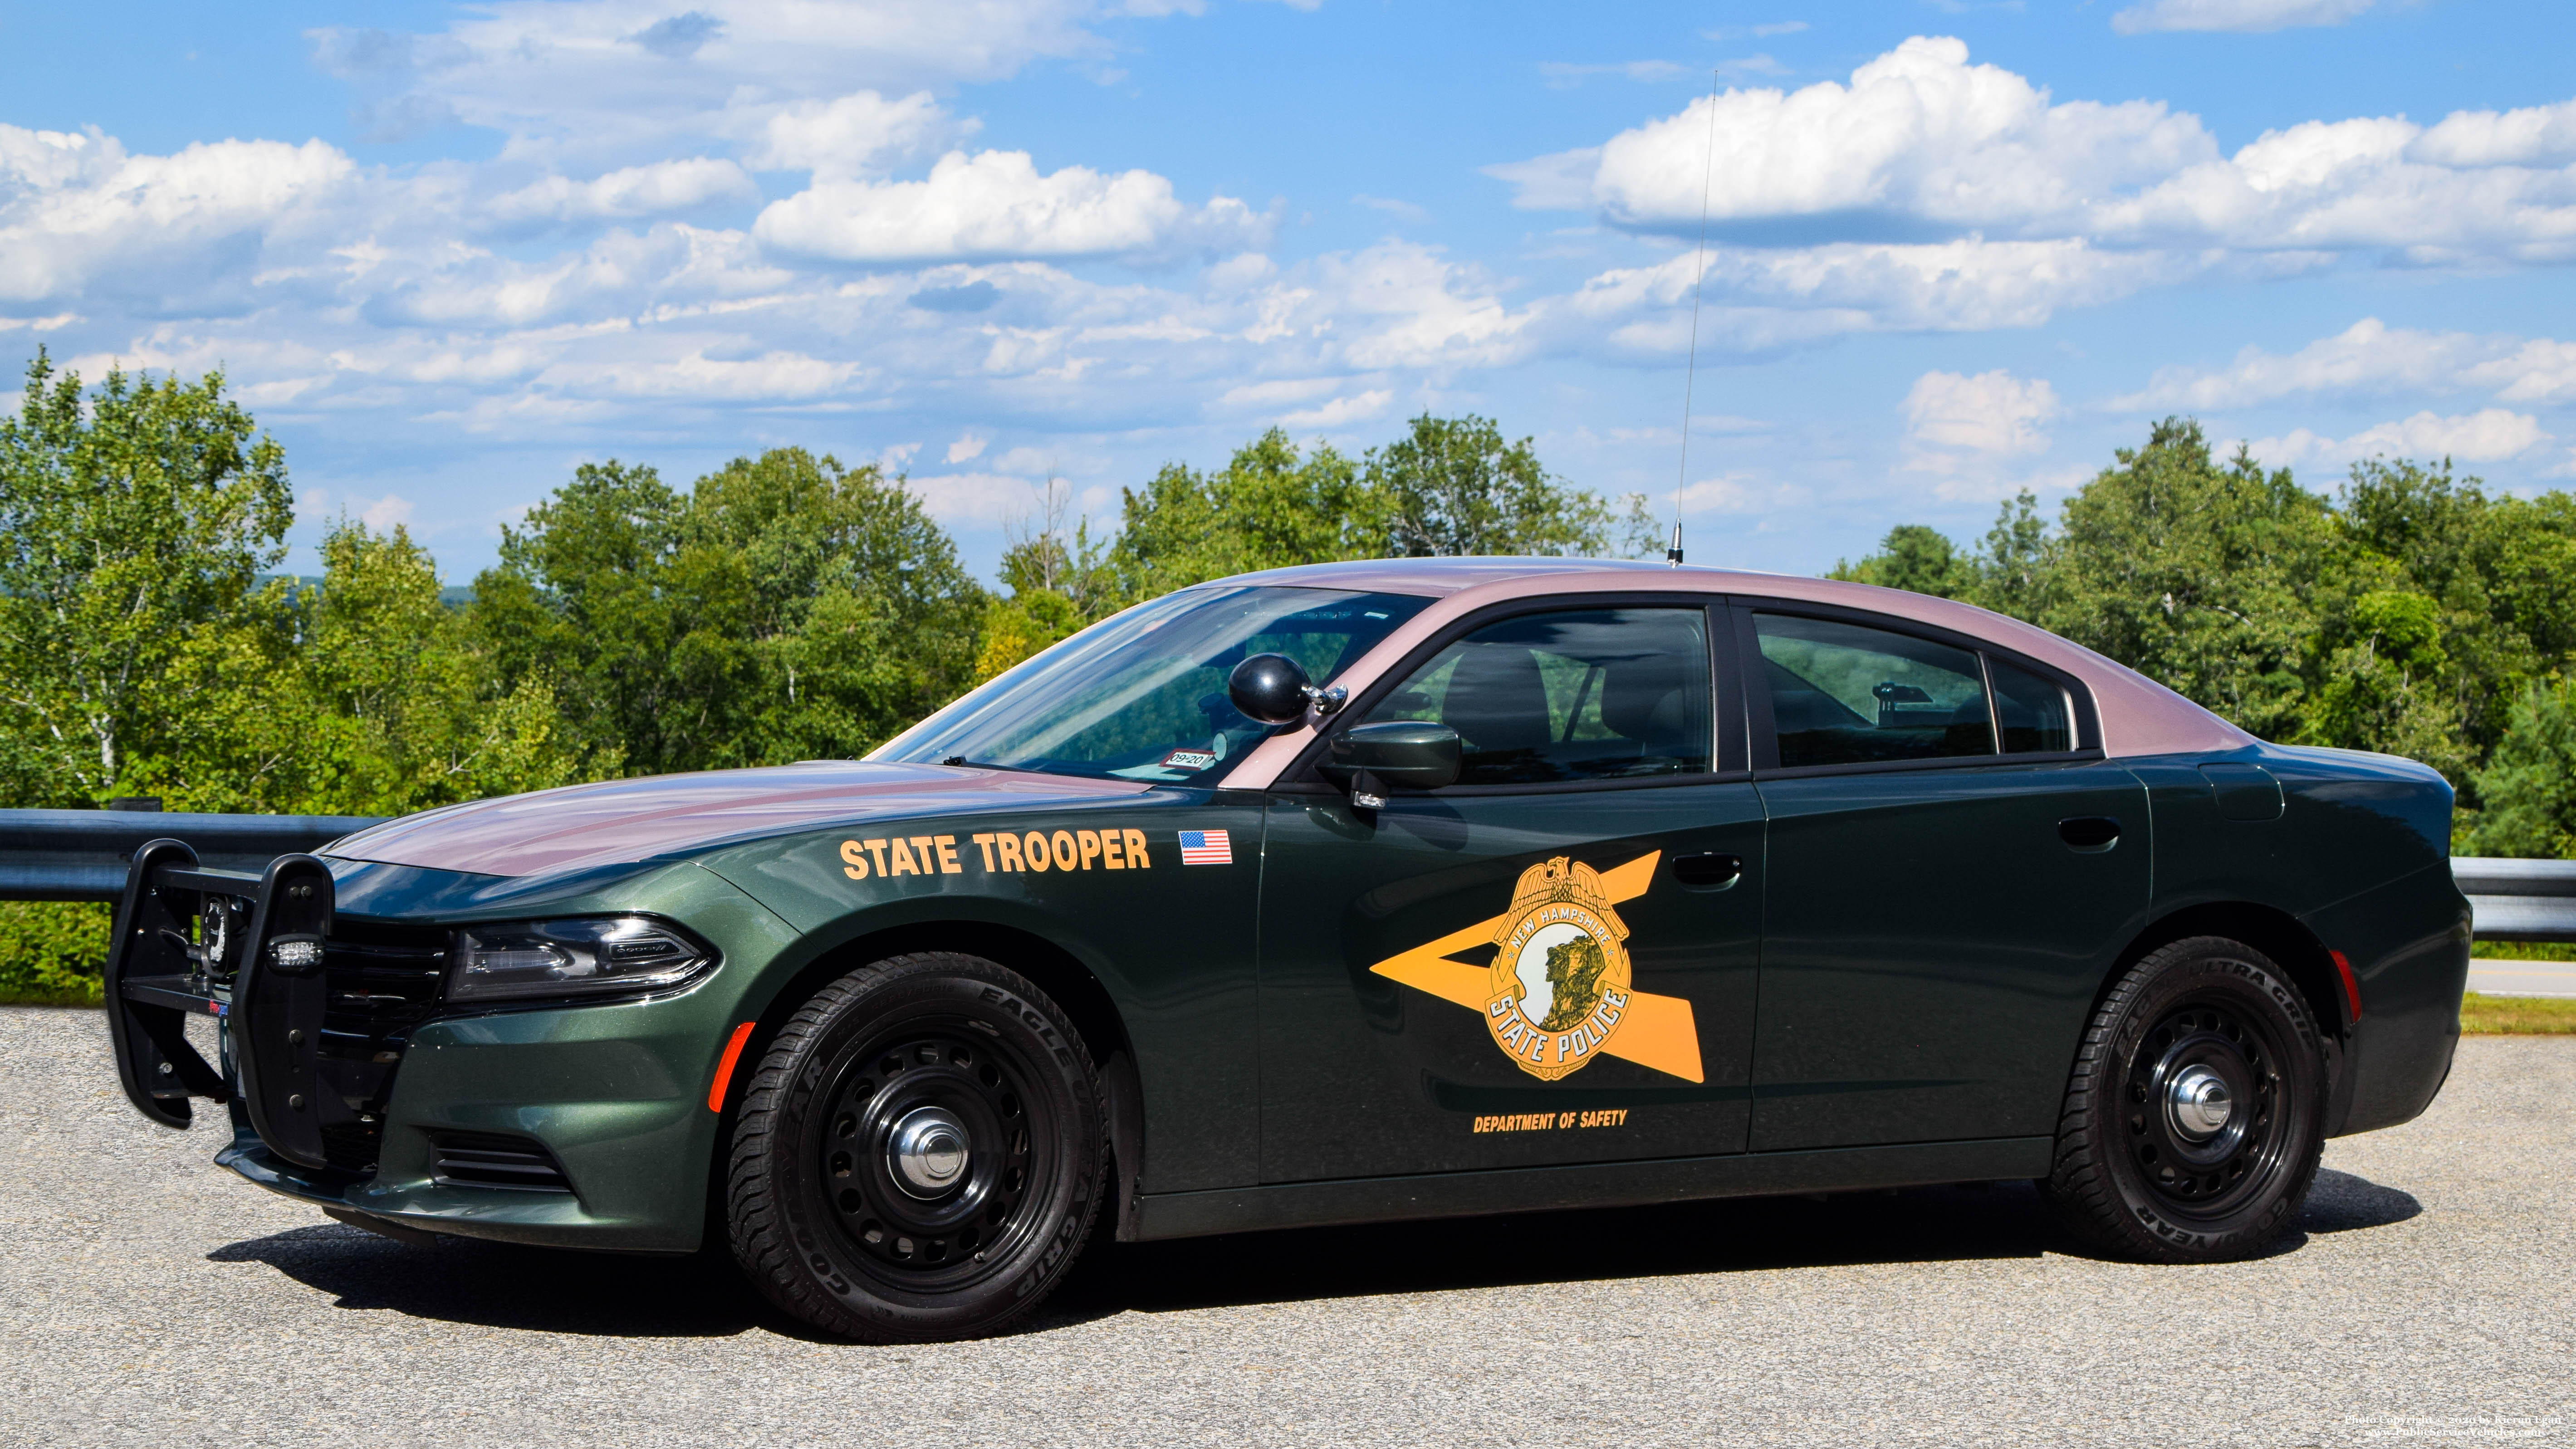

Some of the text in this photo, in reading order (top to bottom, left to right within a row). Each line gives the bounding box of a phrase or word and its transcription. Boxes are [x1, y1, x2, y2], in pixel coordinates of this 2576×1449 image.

[1170, 754, 1204, 764] 09-20
[840, 828, 1151, 880] STATE TROOPER
[1510, 907, 1610, 949] NEW HAMPSHIRE
[977, 987, 1073, 1070] EAGLE
[1490, 988, 1629, 1062] STATE POLICE
[2272, 985, 2315, 1050] GRIP
[1474, 1109, 1628, 1133] DEPARTMENT OF SAFETY
[1016, 1215, 1077, 1299] GRIP
